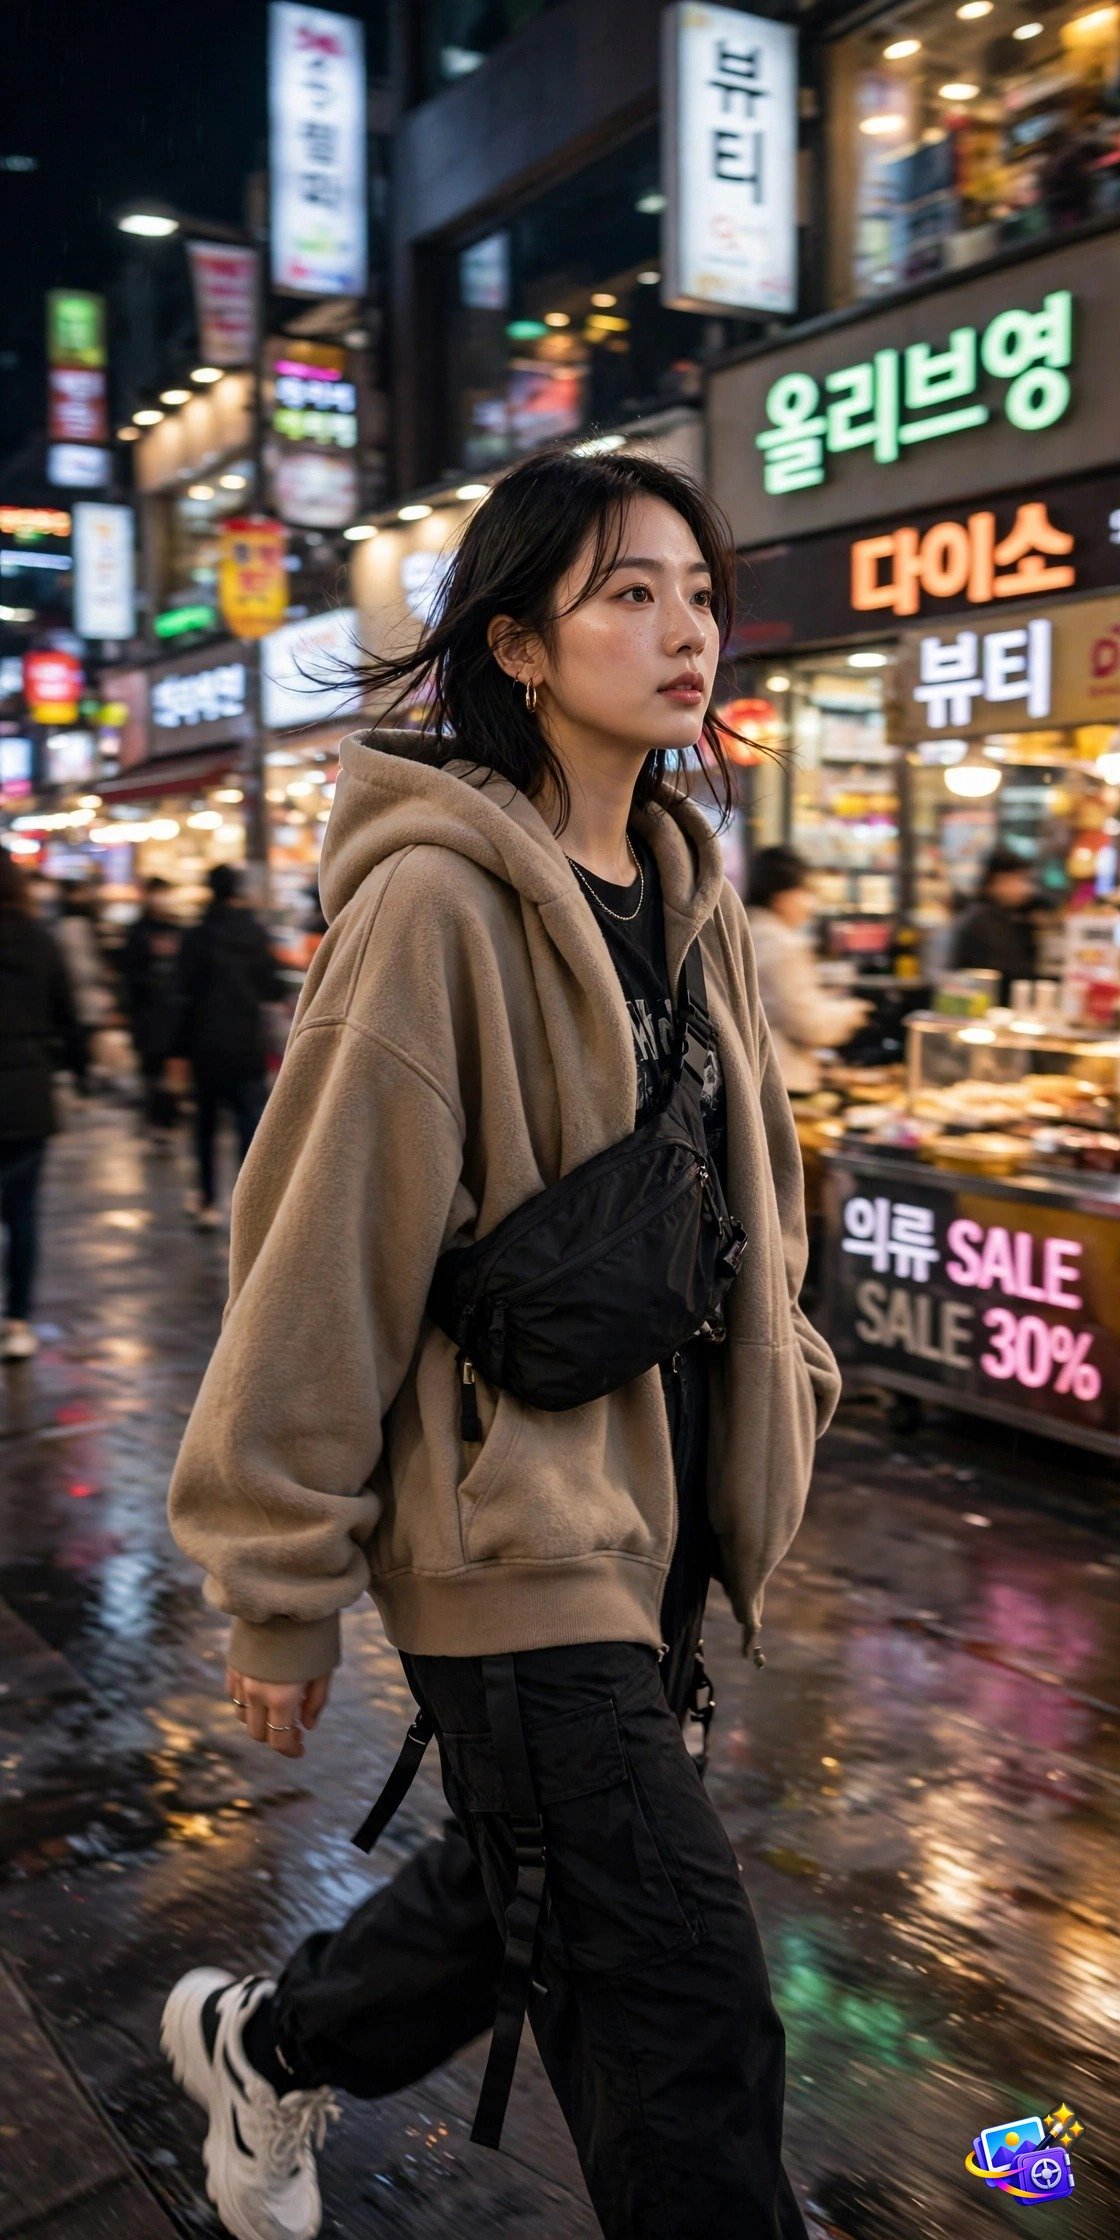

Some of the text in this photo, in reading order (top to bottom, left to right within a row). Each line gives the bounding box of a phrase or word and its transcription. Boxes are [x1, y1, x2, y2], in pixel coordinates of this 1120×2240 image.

[708, 39, 769, 203] 뷰티
[757, 290, 1072, 494] 올리브영
[852, 503, 1075, 615] 다이소
[914, 620, 1051, 728] 뷰티
[842, 1197, 1082, 1308] 의류 SALE
[857, 1283, 1101, 1401] SALE 30%
